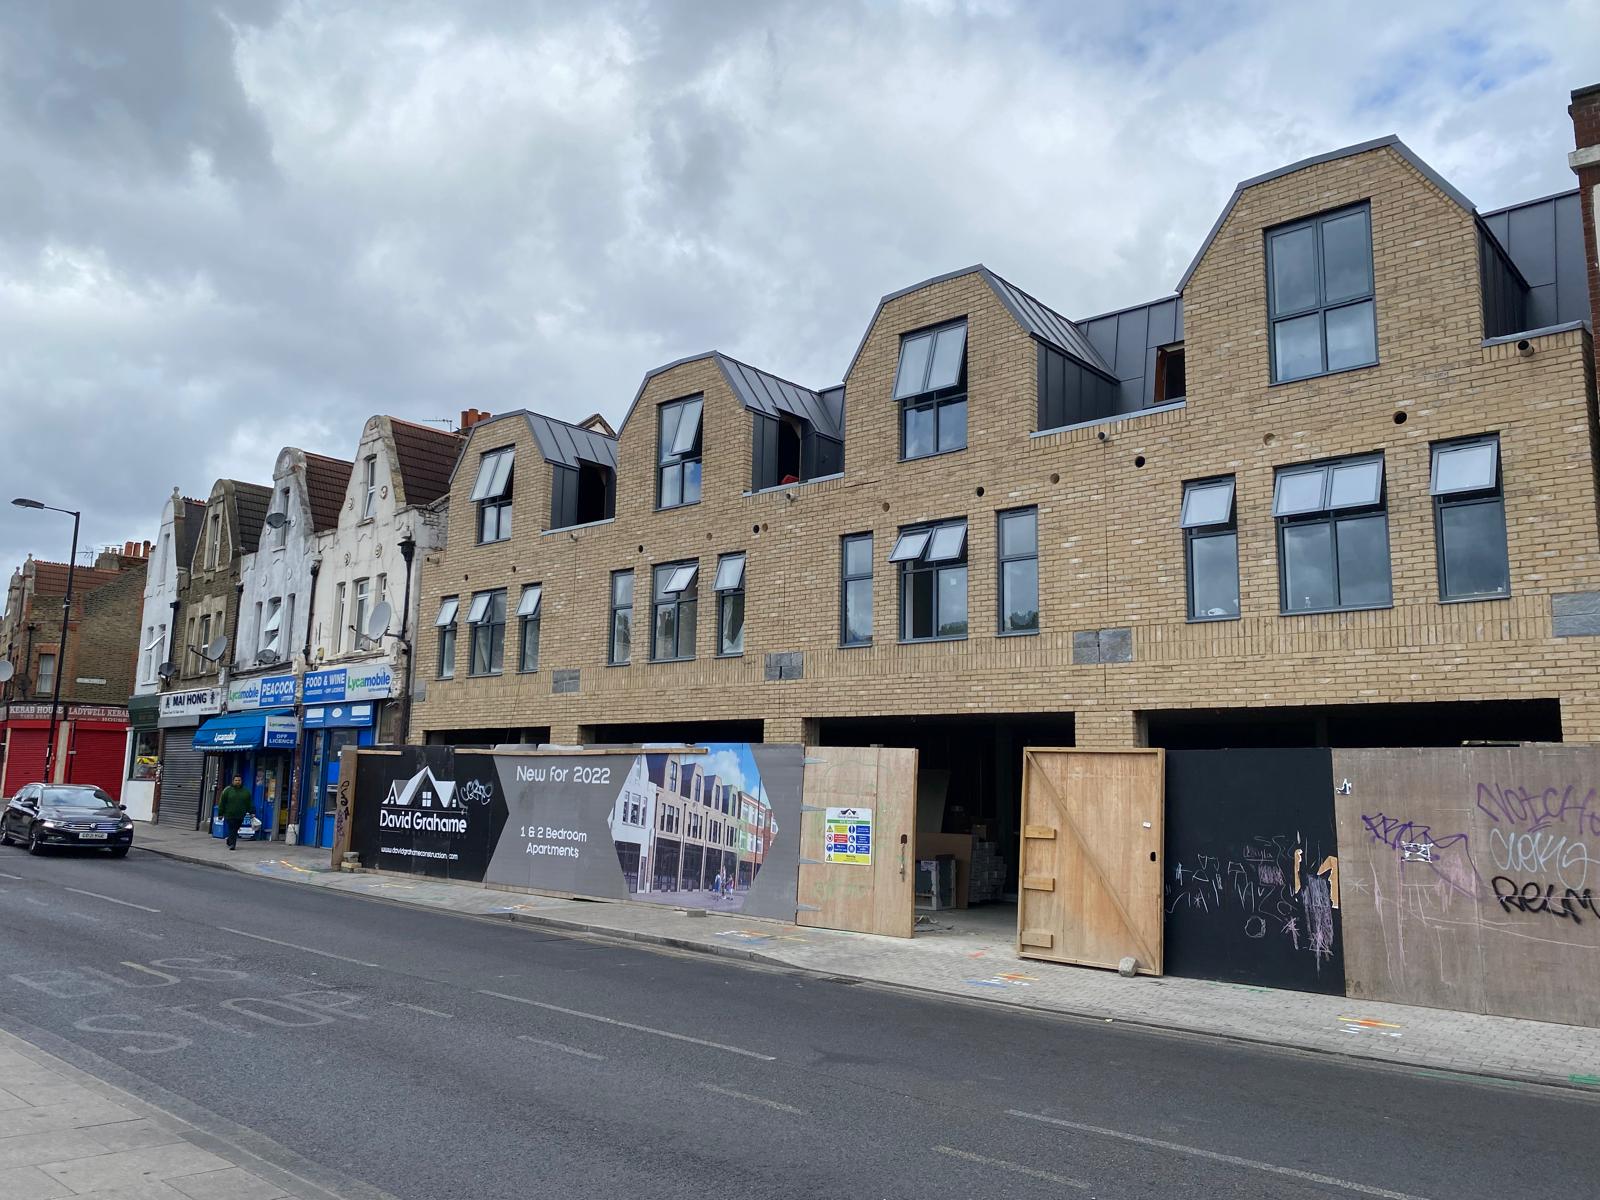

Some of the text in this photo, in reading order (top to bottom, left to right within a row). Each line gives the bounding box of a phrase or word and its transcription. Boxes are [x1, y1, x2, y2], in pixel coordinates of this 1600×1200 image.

[262, 681, 294, 696] PEACOCK
[306, 673, 346, 688] FOOD & WINE
[347, 671, 391, 691] Lycamobile
[172, 695, 186, 707] MAI
[187, 692, 207, 705] HONG
[229, 686, 259, 702] Lycamobile
[10, 705, 64, 714] KEBAB HOUE
[68, 707, 106, 717] LADYWELL
[516, 765, 611, 784] New for 2022
[380, 809, 467, 833] David Grahame
[520, 825, 587, 842] 1 & 2 Bedroom
[526, 842, 580, 858] Apartments
[7, 957, 250, 999] BUS
[73, 990, 372, 1053] STOP
